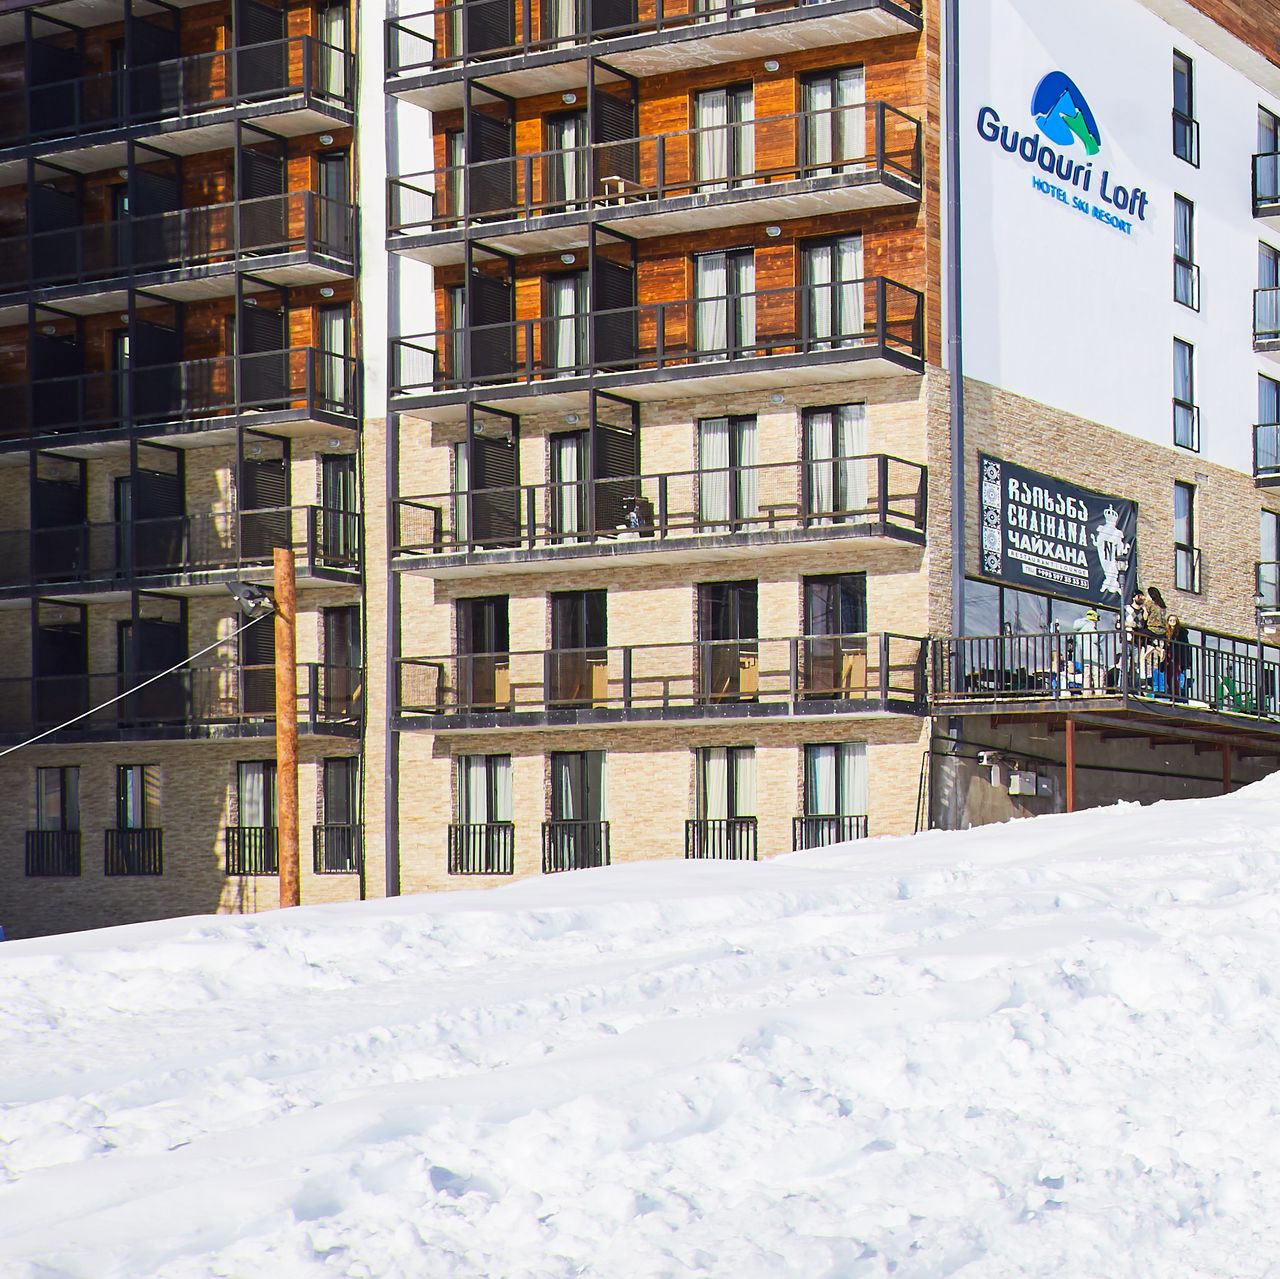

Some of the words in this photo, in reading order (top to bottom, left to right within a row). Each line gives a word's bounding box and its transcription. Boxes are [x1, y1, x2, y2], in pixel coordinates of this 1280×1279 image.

[977, 106, 1093, 191] Gudauri
[1100, 171, 1149, 221] Loft
[1032, 175, 1070, 205] HOTEL
[1072, 196, 1089, 214] SKI
[1092, 206, 1133, 235] RESORT
[1007, 503, 1088, 547] CHAIHANA
[1007, 530, 1089, 567] ЧАЙХАНА
[1010, 550, 1054, 568] RESTAURANT
[1060, 564, 1087, 576] LOUNGE
